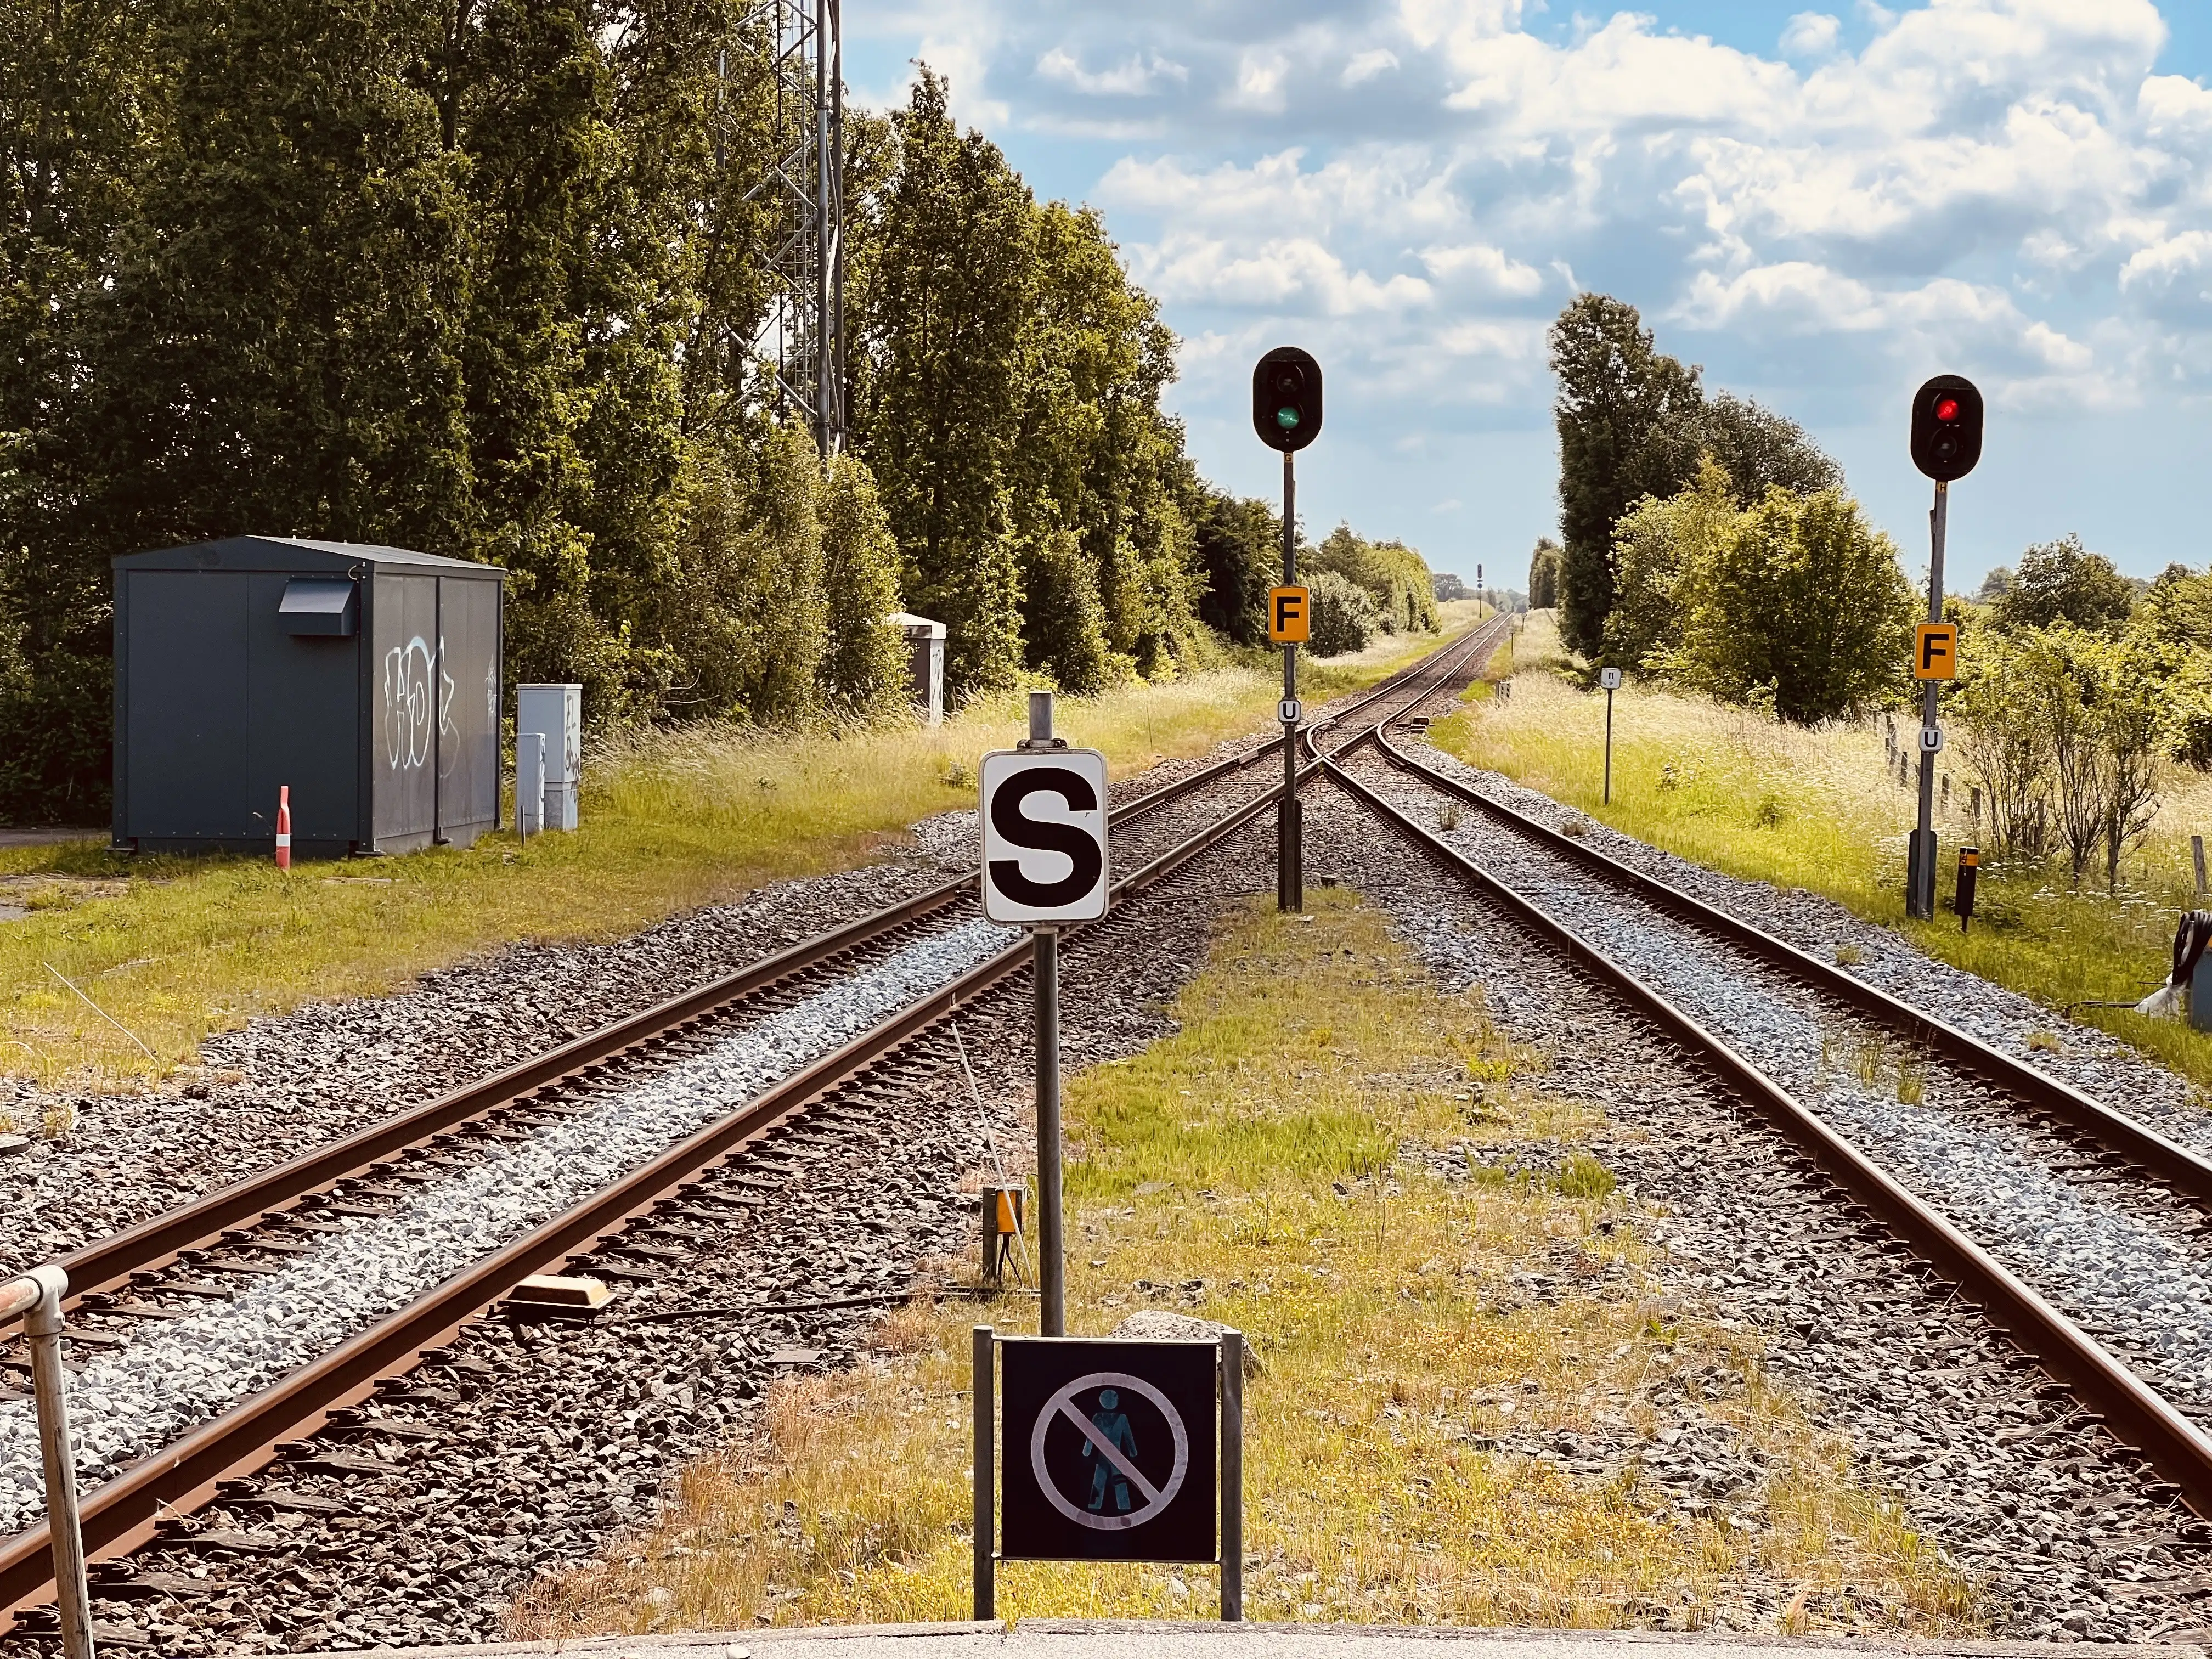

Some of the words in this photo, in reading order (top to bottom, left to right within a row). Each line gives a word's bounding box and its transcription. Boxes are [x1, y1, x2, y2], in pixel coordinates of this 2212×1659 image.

[1940, 483, 1946, 492] H
[1277, 596, 1302, 632] F
[1922, 633, 1949, 669] F
[1283, 703, 1296, 720] U
[1925, 731, 1938, 748] U
[989, 767, 1102, 908] S
